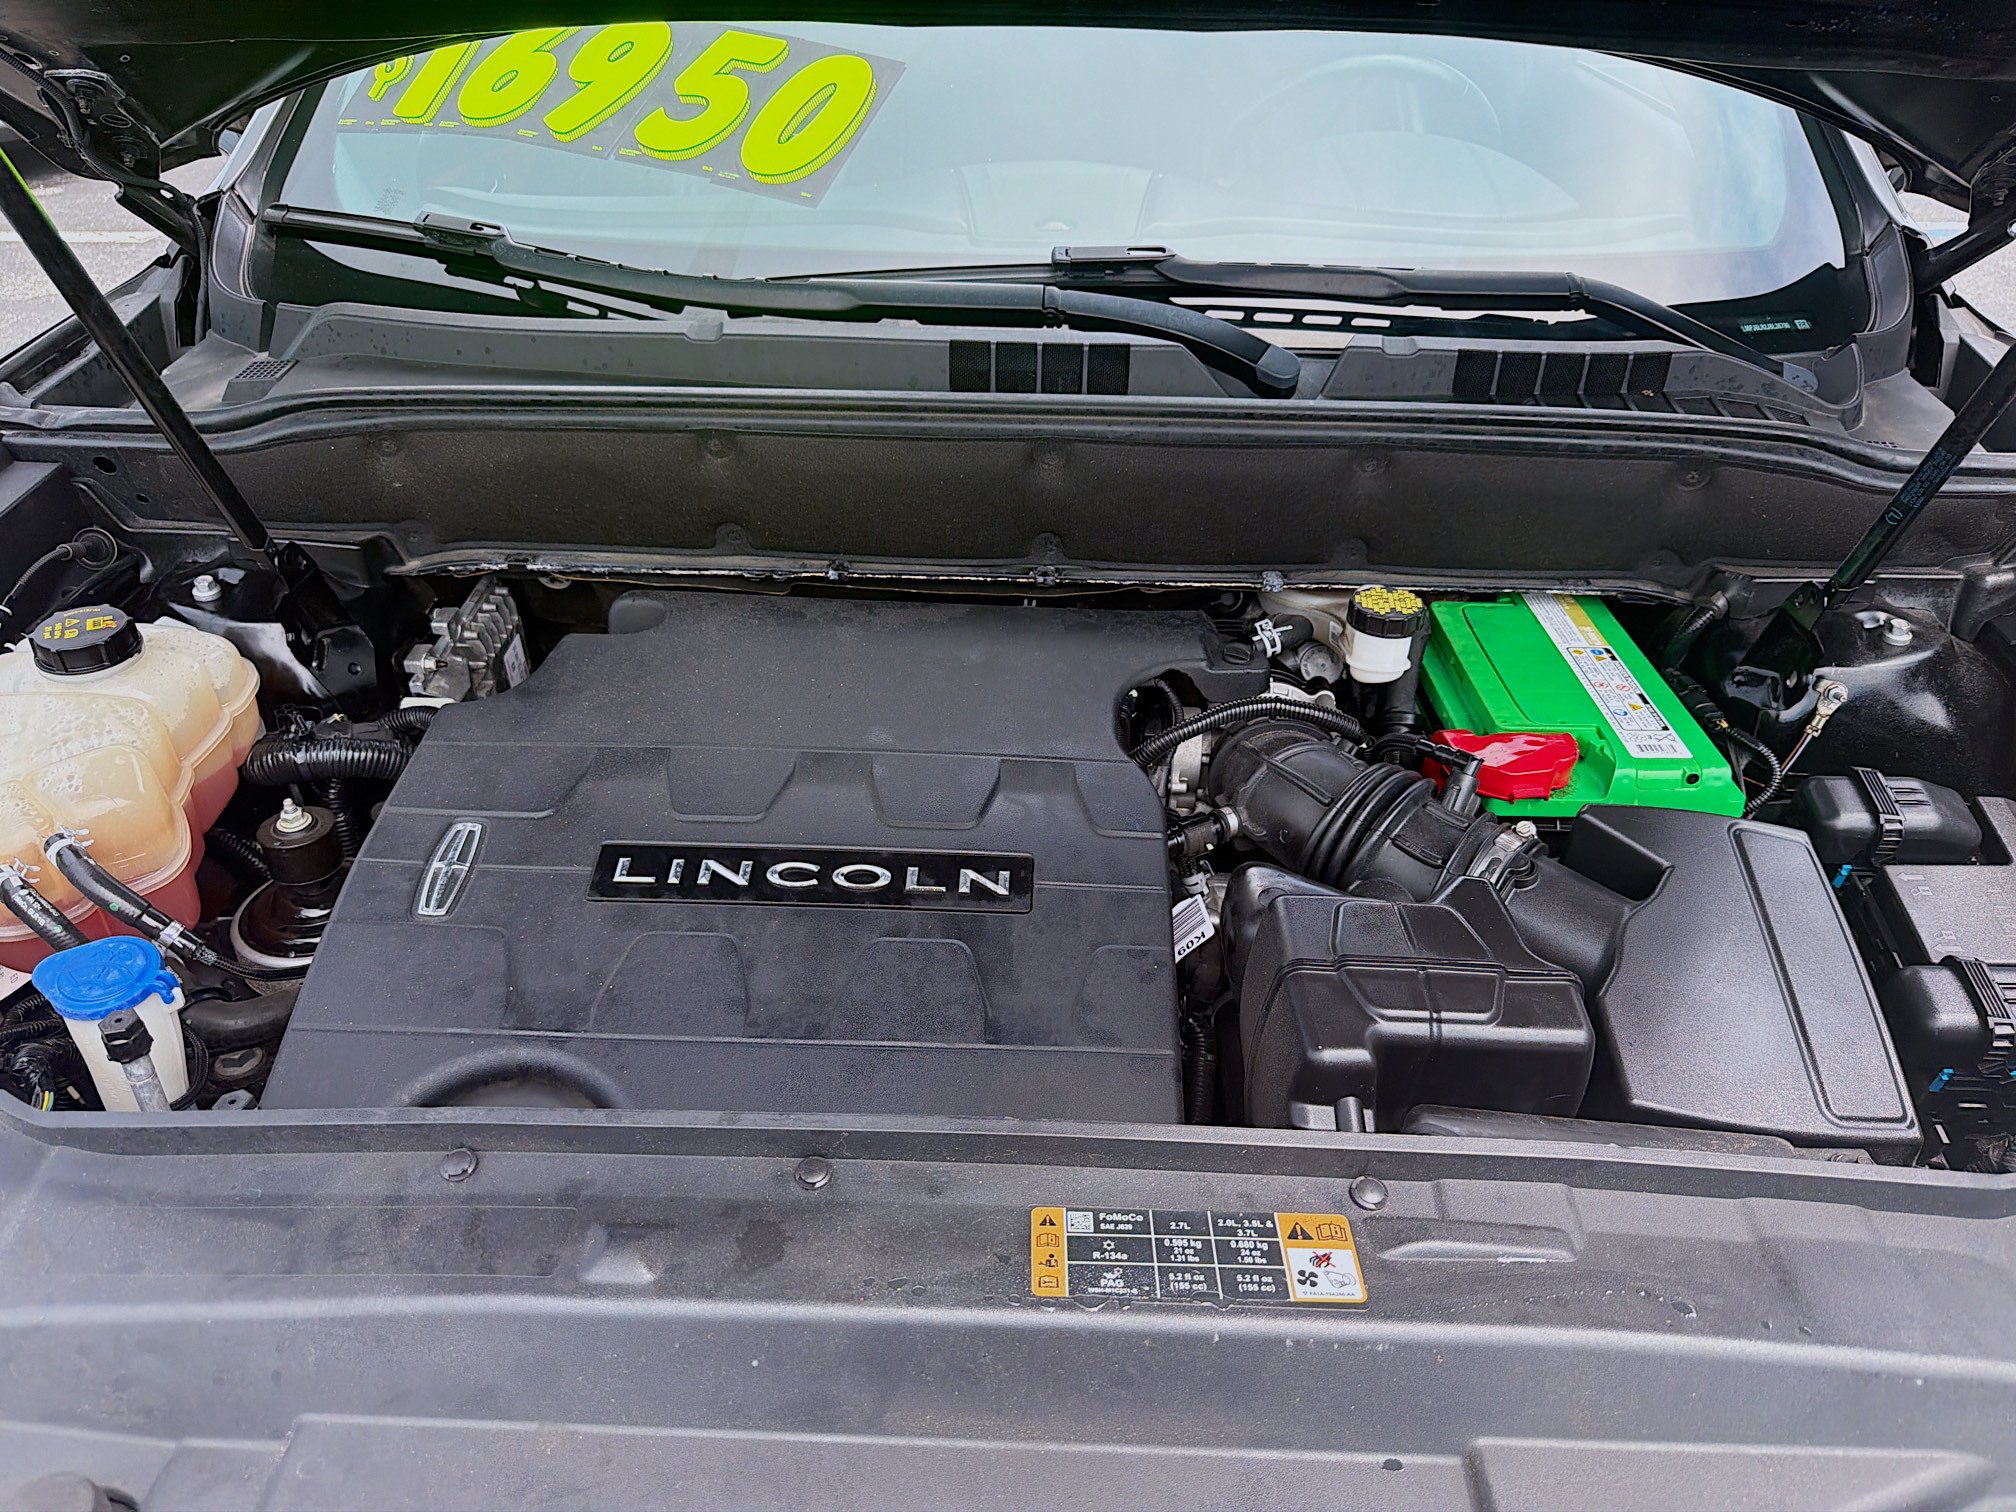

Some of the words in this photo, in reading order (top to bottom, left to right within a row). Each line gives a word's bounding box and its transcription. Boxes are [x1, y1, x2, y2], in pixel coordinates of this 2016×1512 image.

[613, 857, 1010, 896] LINCOLN
[1178, 931, 1206, 956] K09
[1100, 1213, 1144, 1222] FoMoCo
[1170, 1221, 1191, 1230] 2.7L
[1218, 1219, 1241, 1228] 2.0L,
[1243, 1219, 1264, 1228] 3.5L
[1265, 1220, 1274, 1228] &
[1237, 1229, 1258, 1237] 3.7L
[1164, 1238, 1188, 1247] 0.595
[1190, 1239, 1202, 1249] kg
[1230, 1240, 1254, 1249] 0.680
[1256, 1240, 1269, 1251] kg
[1093, 1251, 1128, 1260] R-134a
[1173, 1247, 1183, 1255] 21
[1170, 1254, 1186, 1262] 1.31
[1187, 1254, 1200, 1262] lbs
[1237, 1256, 1254, 1264] 1.50
[1255, 1256, 1268, 1264] lbs
[1168, 1272, 1183, 1281] 5.2
[1184, 1272, 1193, 1281] fl
[1236, 1274, 1251, 1283] 5.2
[1252, 1274, 1260, 1282] fl
[1261, 1275, 1273, 1283] oz
[1100, 1279, 1125, 1287] PAG
[1170, 1281, 1190, 1290] (155
[1192, 1282, 1207, 1291] cc)
[1238, 1283, 1259, 1292] (155
[1260, 1284, 1276, 1293] cc)
